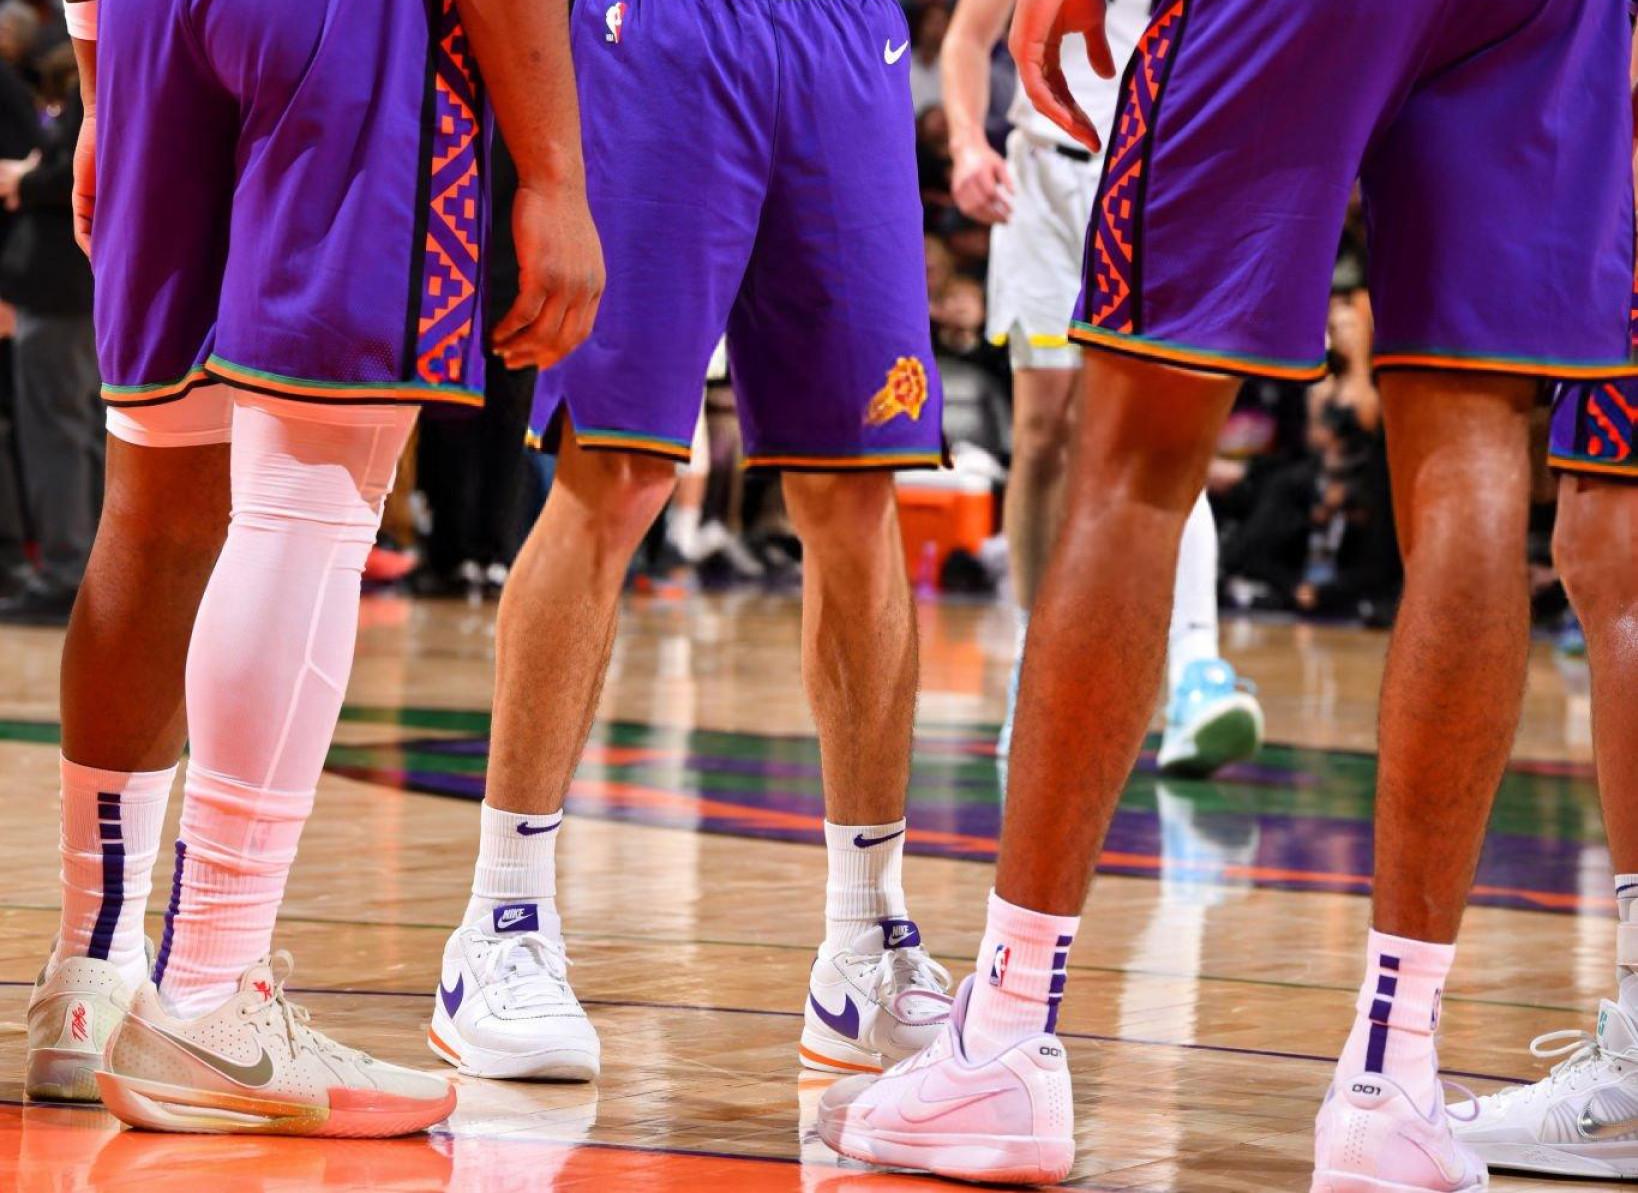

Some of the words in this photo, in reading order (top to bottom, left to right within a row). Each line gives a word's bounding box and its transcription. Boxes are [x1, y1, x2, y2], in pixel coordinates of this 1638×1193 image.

[502, 908, 525, 920] NIKE
[892, 925, 909, 937] NIKE
[1352, 1083, 1382, 1096] 001
